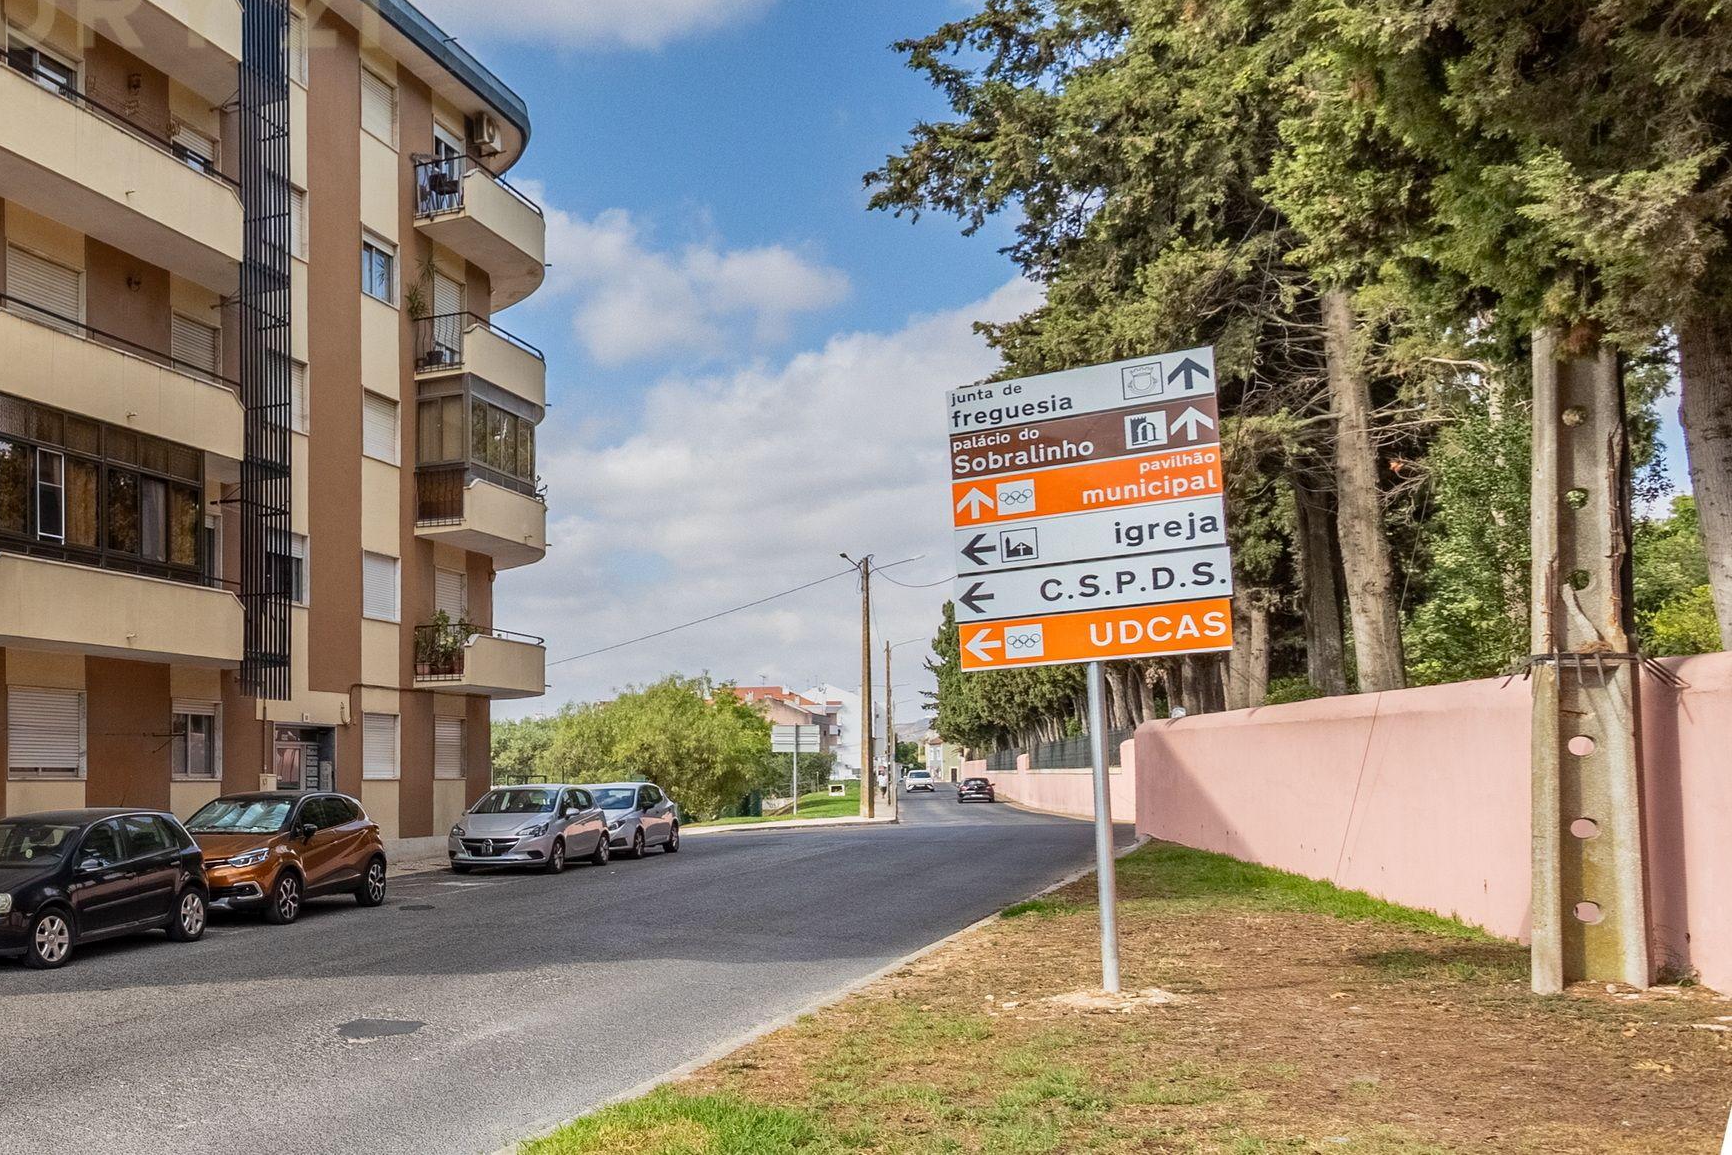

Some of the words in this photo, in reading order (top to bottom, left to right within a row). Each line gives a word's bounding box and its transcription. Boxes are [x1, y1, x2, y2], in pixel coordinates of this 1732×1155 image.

[951, 389, 993, 407] junta
[1003, 384, 1022, 397] de
[952, 395, 1073, 428] freguesia
[952, 432, 1011, 453] palácio
[1018, 428, 1040, 441] do
[954, 440, 1095, 474] Sobralinho
[1139, 451, 1216, 475] pavilhão
[1082, 470, 1218, 505] municipal
[1114, 512, 1219, 547] igreja
[1040, 561, 1227, 601] C.S.P.D.S.
[1089, 611, 1227, 647] UDCAS
